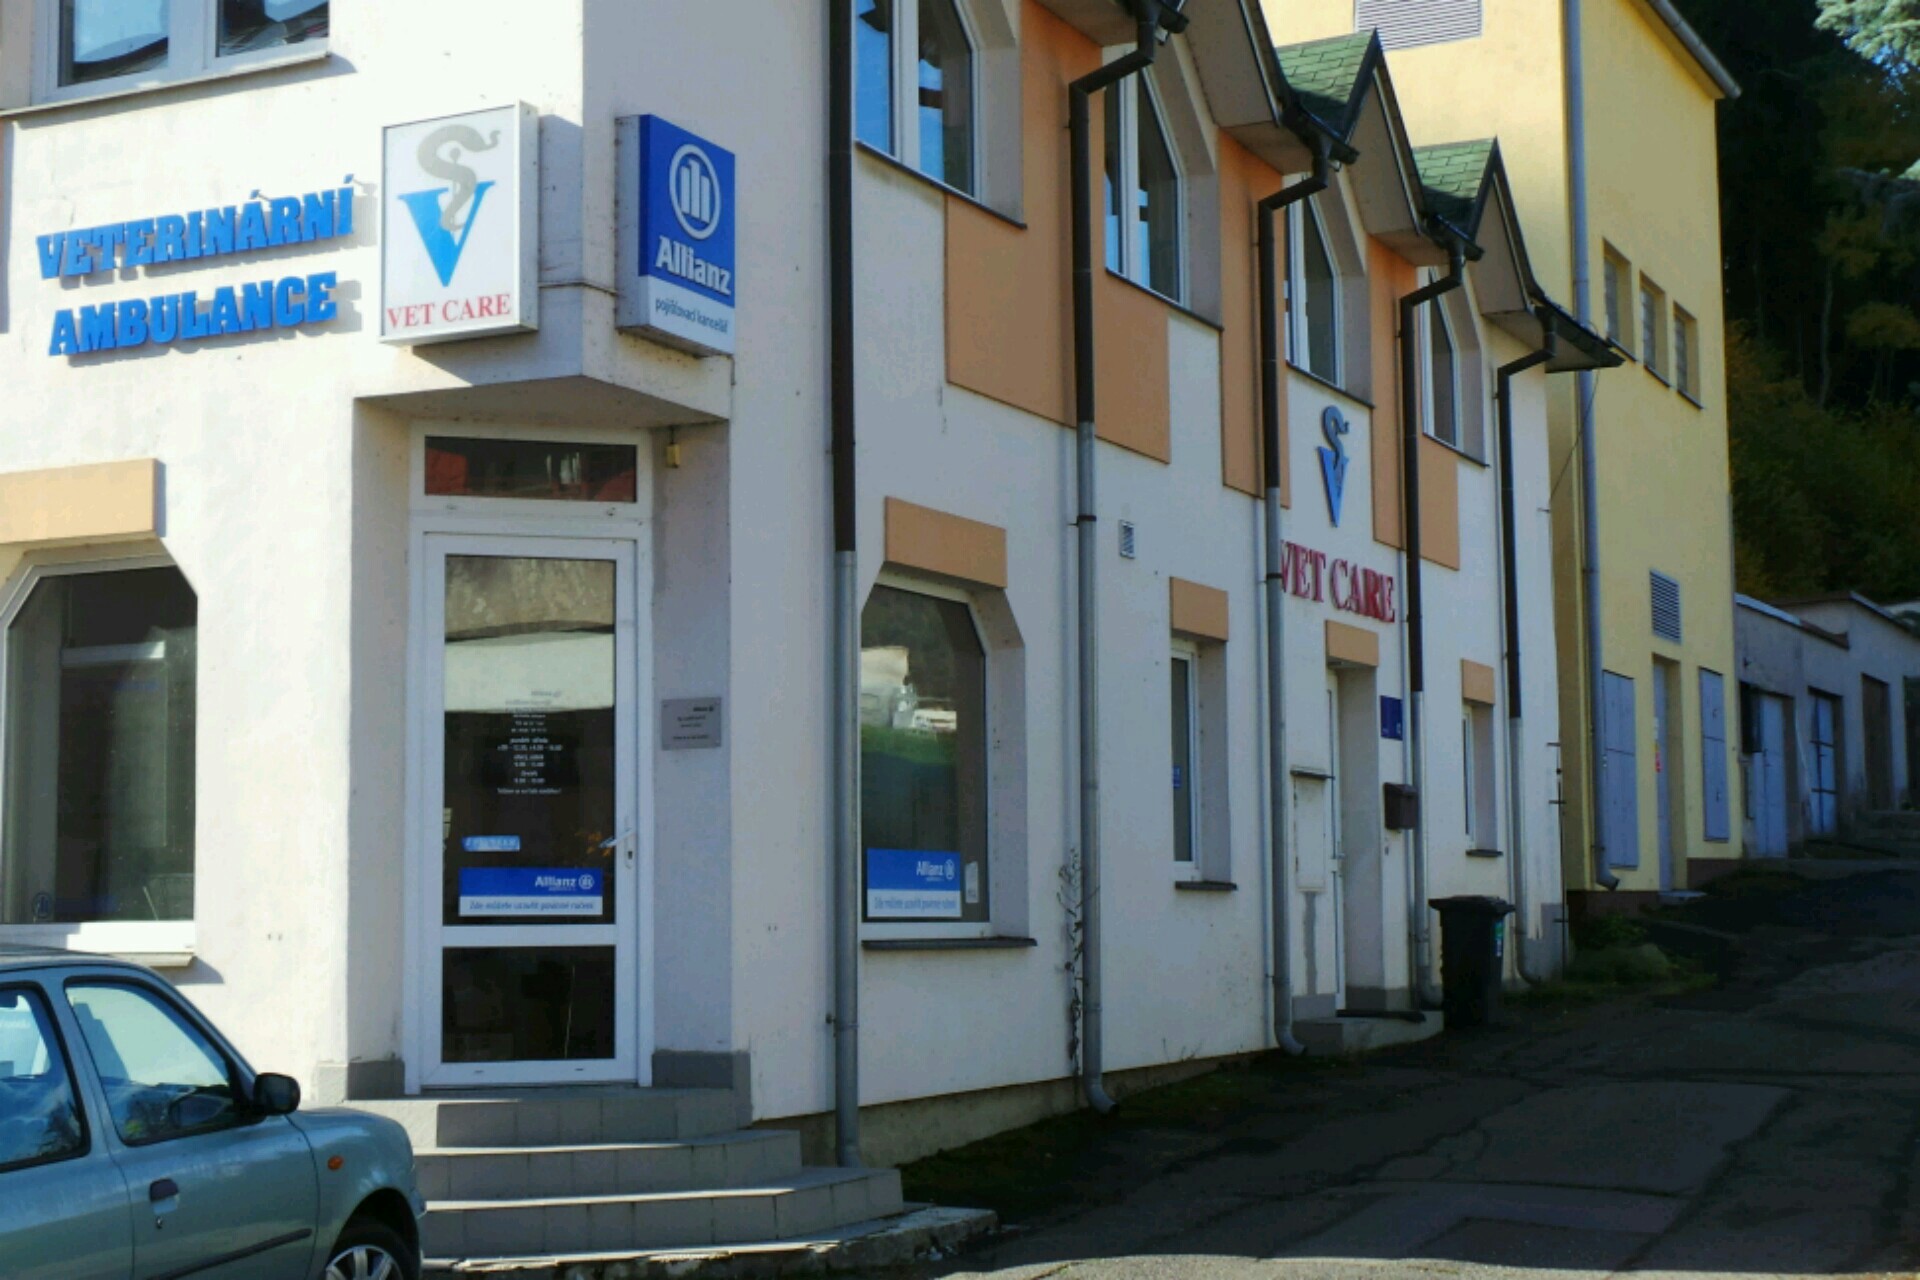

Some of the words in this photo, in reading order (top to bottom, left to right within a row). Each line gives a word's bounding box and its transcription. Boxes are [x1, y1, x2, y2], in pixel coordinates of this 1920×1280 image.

[36, 174, 354, 279] VETERINÁRNÍ
[656, 235, 731, 297] Allianz
[49, 271, 337, 356] AMBULANCE
[387, 304, 435, 329] VET
[442, 293, 511, 323] CARE
[1280, 540, 1326, 603] VET
[1329, 558, 1395, 623] CARE
[535, 876, 576, 888] Allianz
[916, 860, 944, 876] Allianz
